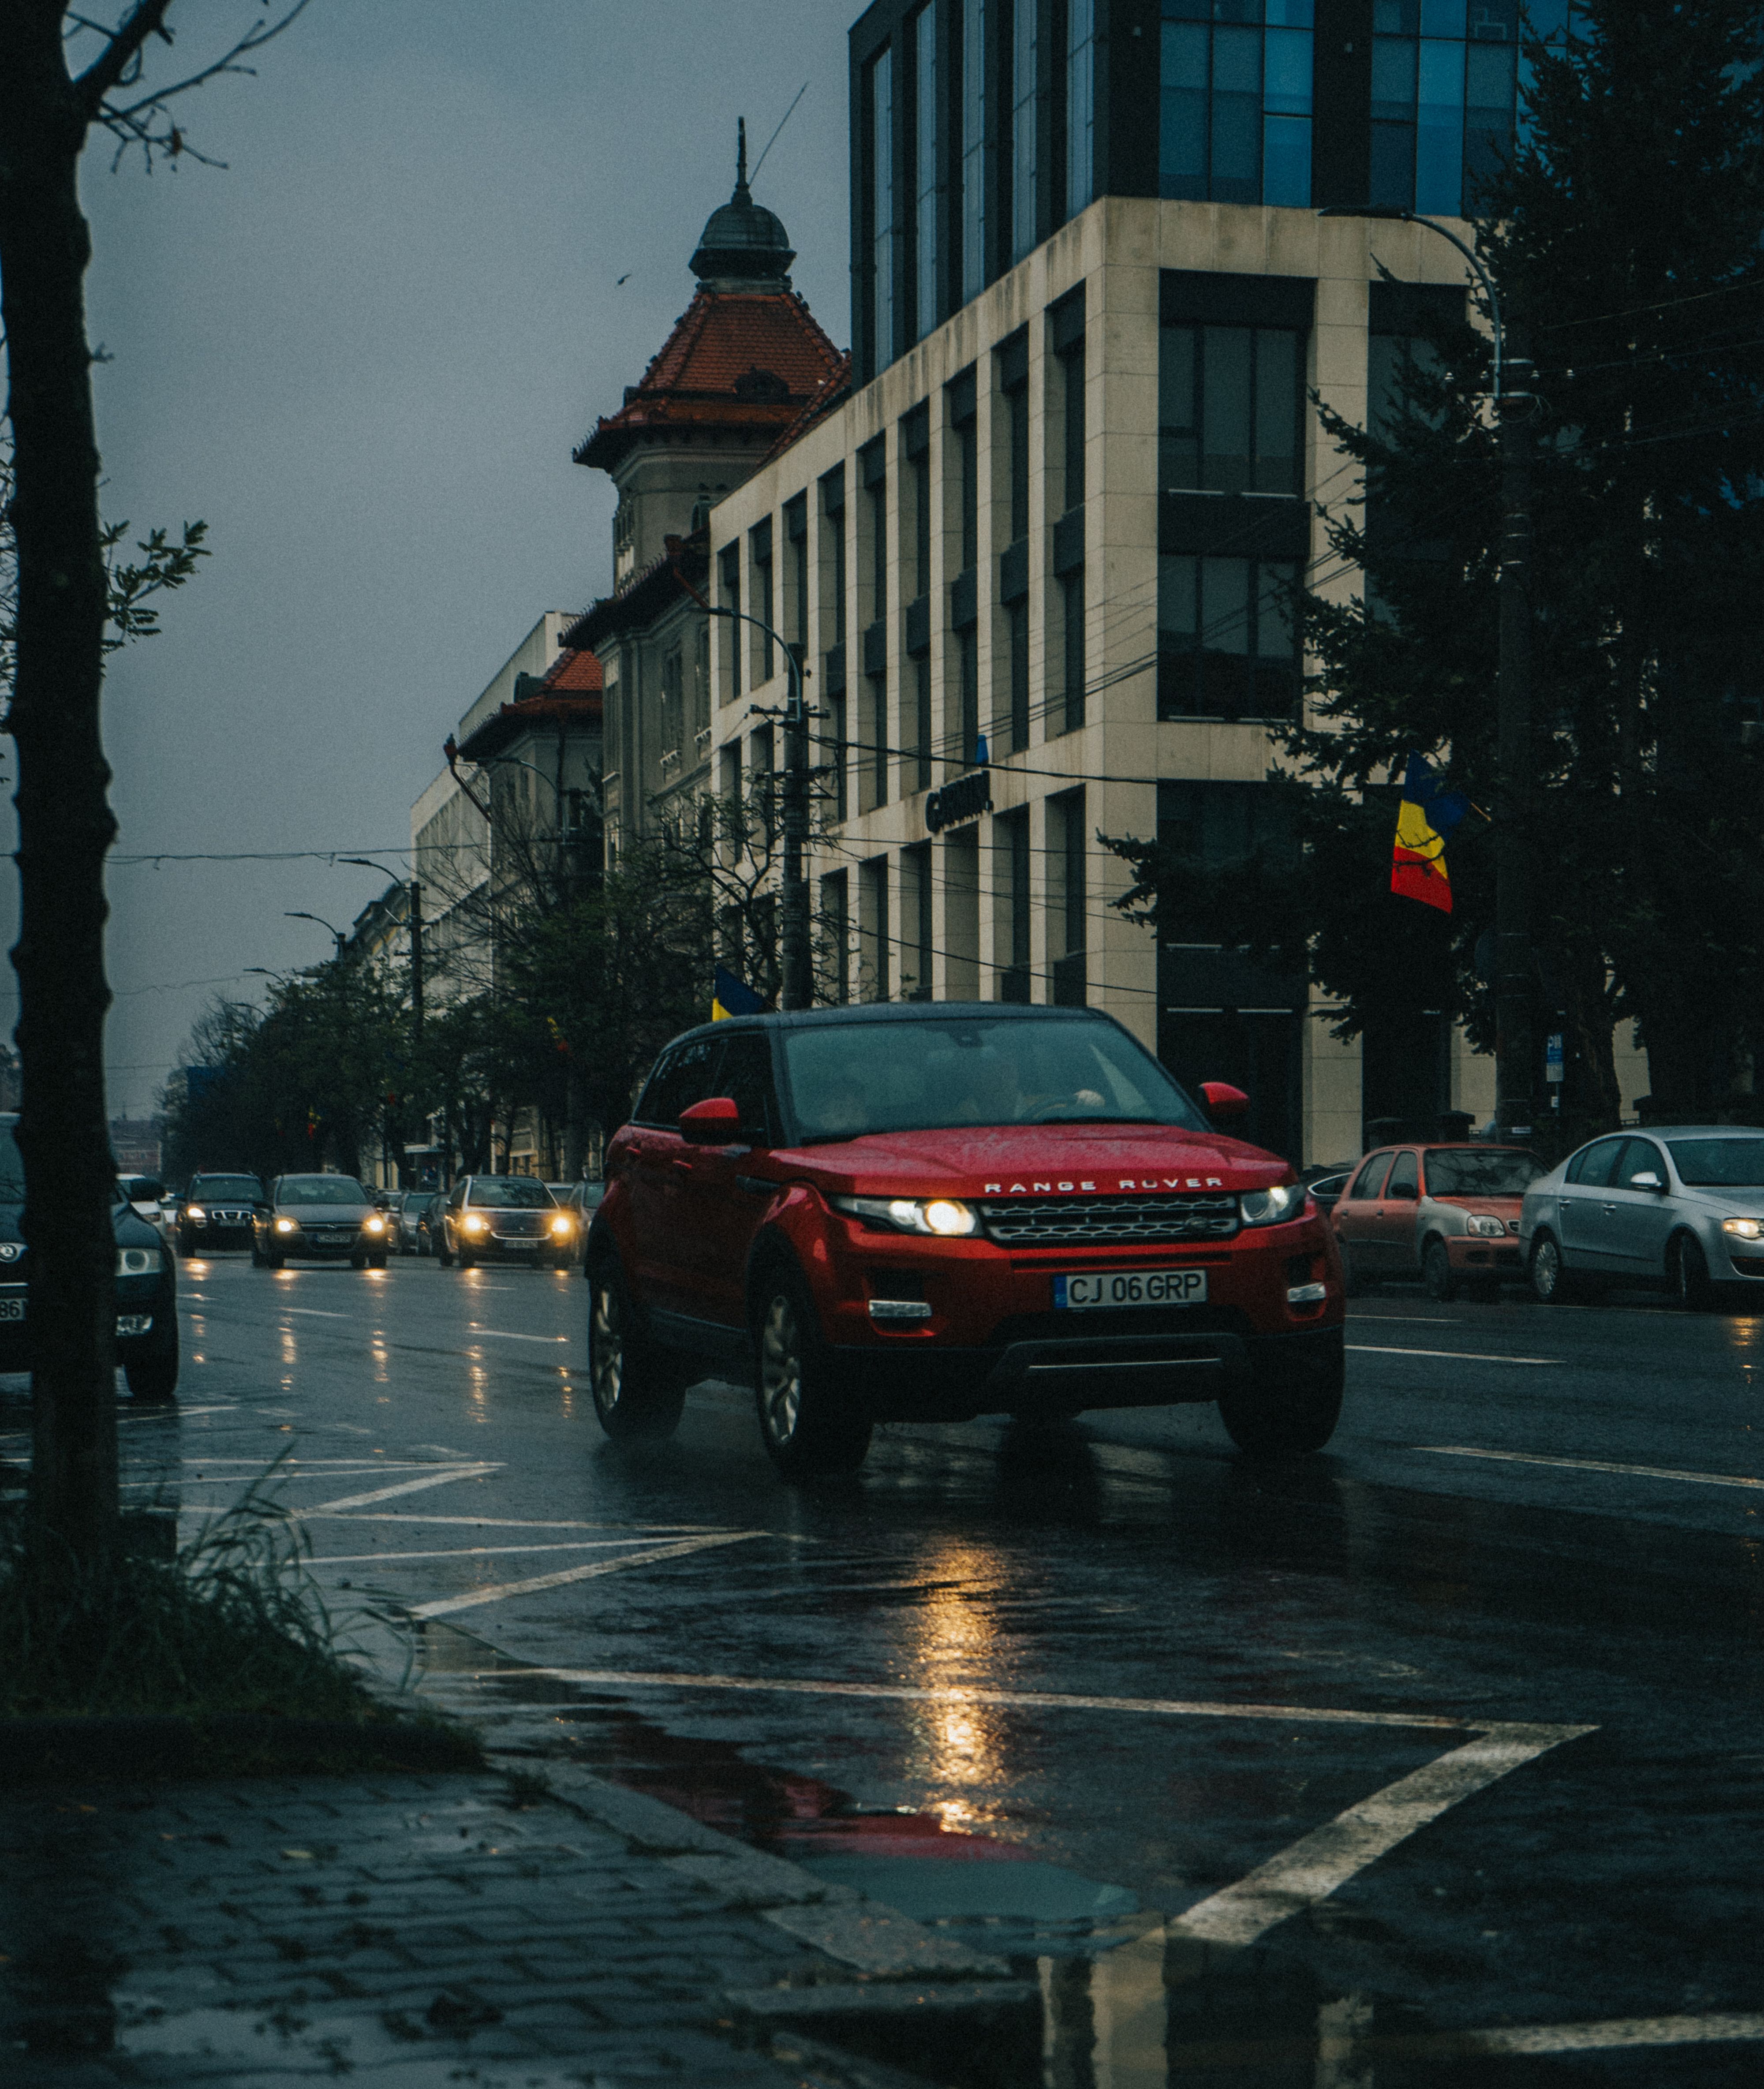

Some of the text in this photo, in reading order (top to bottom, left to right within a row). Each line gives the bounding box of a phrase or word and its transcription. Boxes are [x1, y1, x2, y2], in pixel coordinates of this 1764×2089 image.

[984, 1178, 1222, 1193] RANGE ROVER
[1069, 1274, 1201, 1303] CJ 06 GRP
